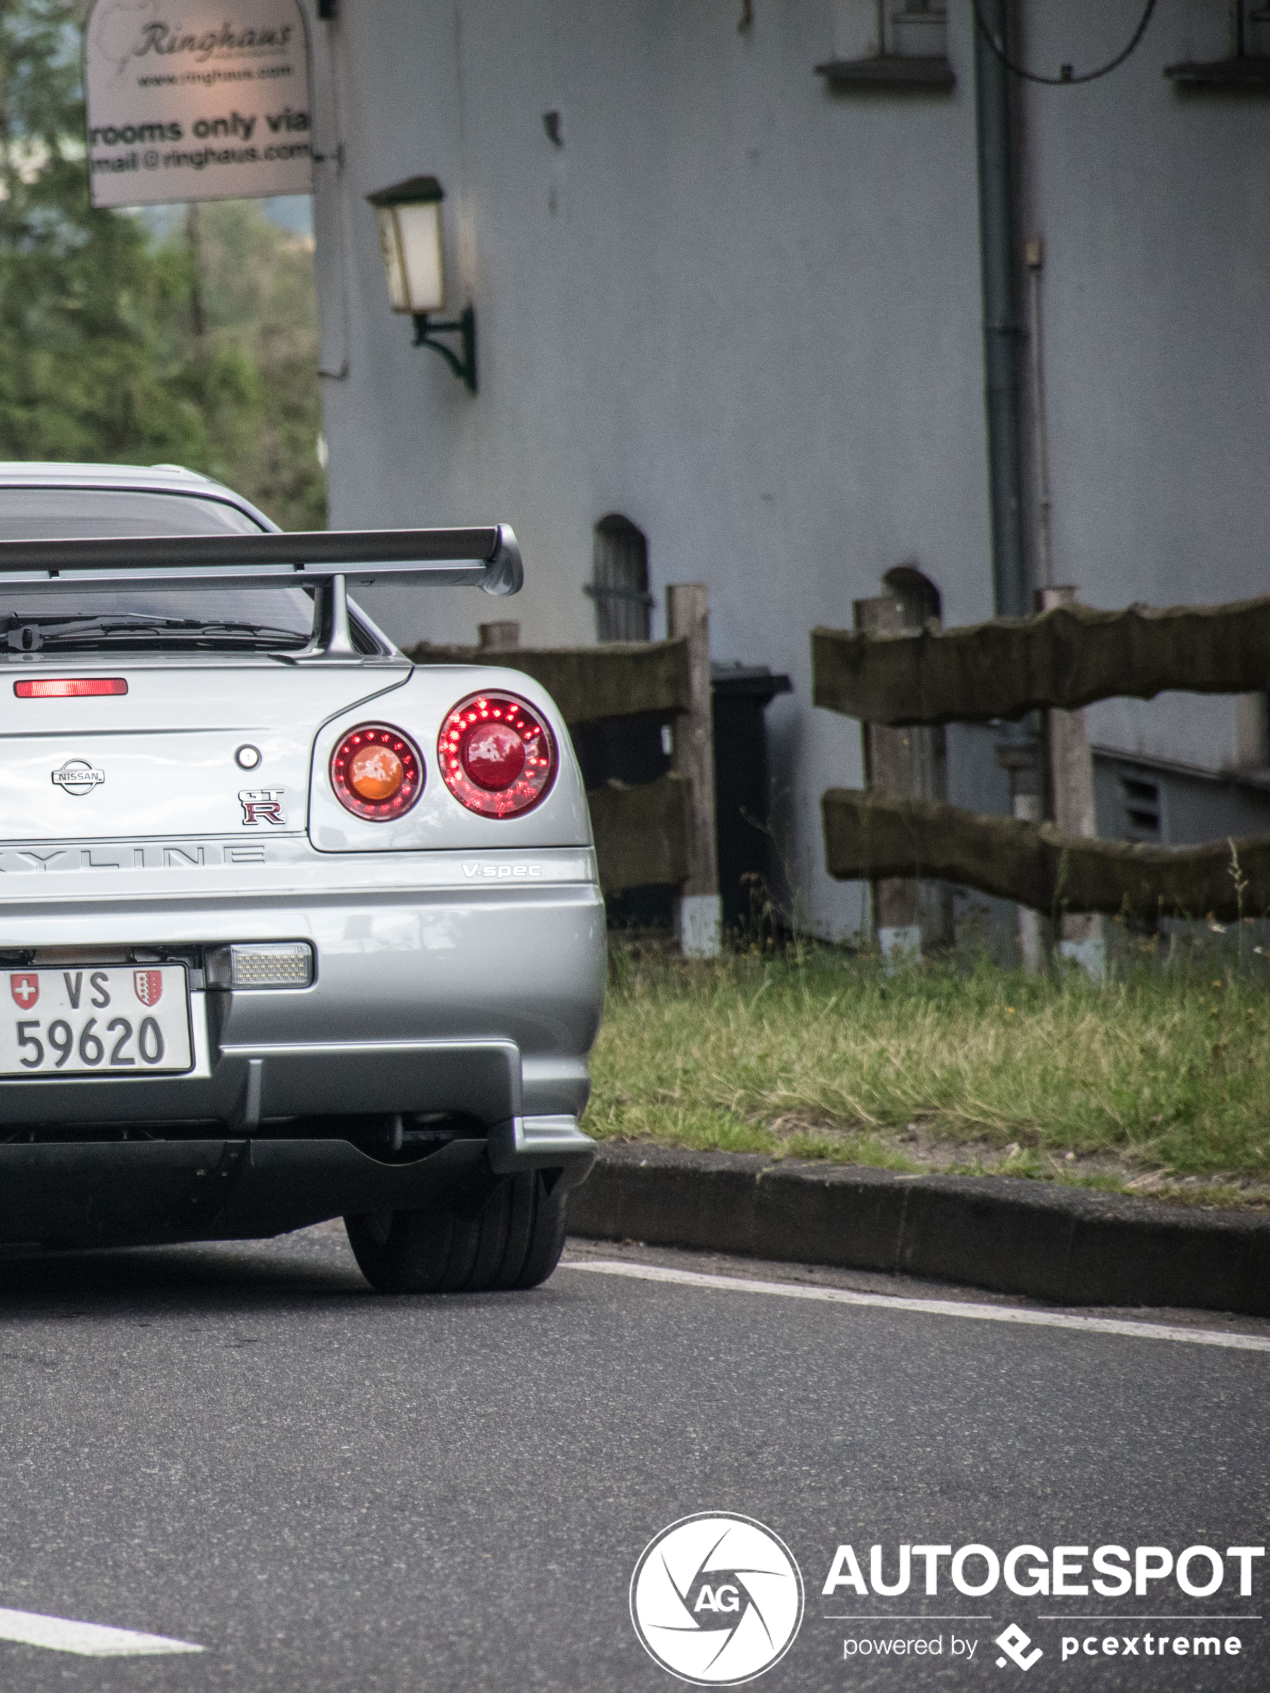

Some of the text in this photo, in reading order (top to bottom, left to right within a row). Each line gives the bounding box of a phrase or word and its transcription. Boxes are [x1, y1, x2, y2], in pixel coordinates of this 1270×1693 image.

[90, 107, 310, 147] rooms only via
[58, 772, 99, 781] NISSAN
[63, 972, 111, 1009] VS
[17, 1016, 164, 1068] 59620
